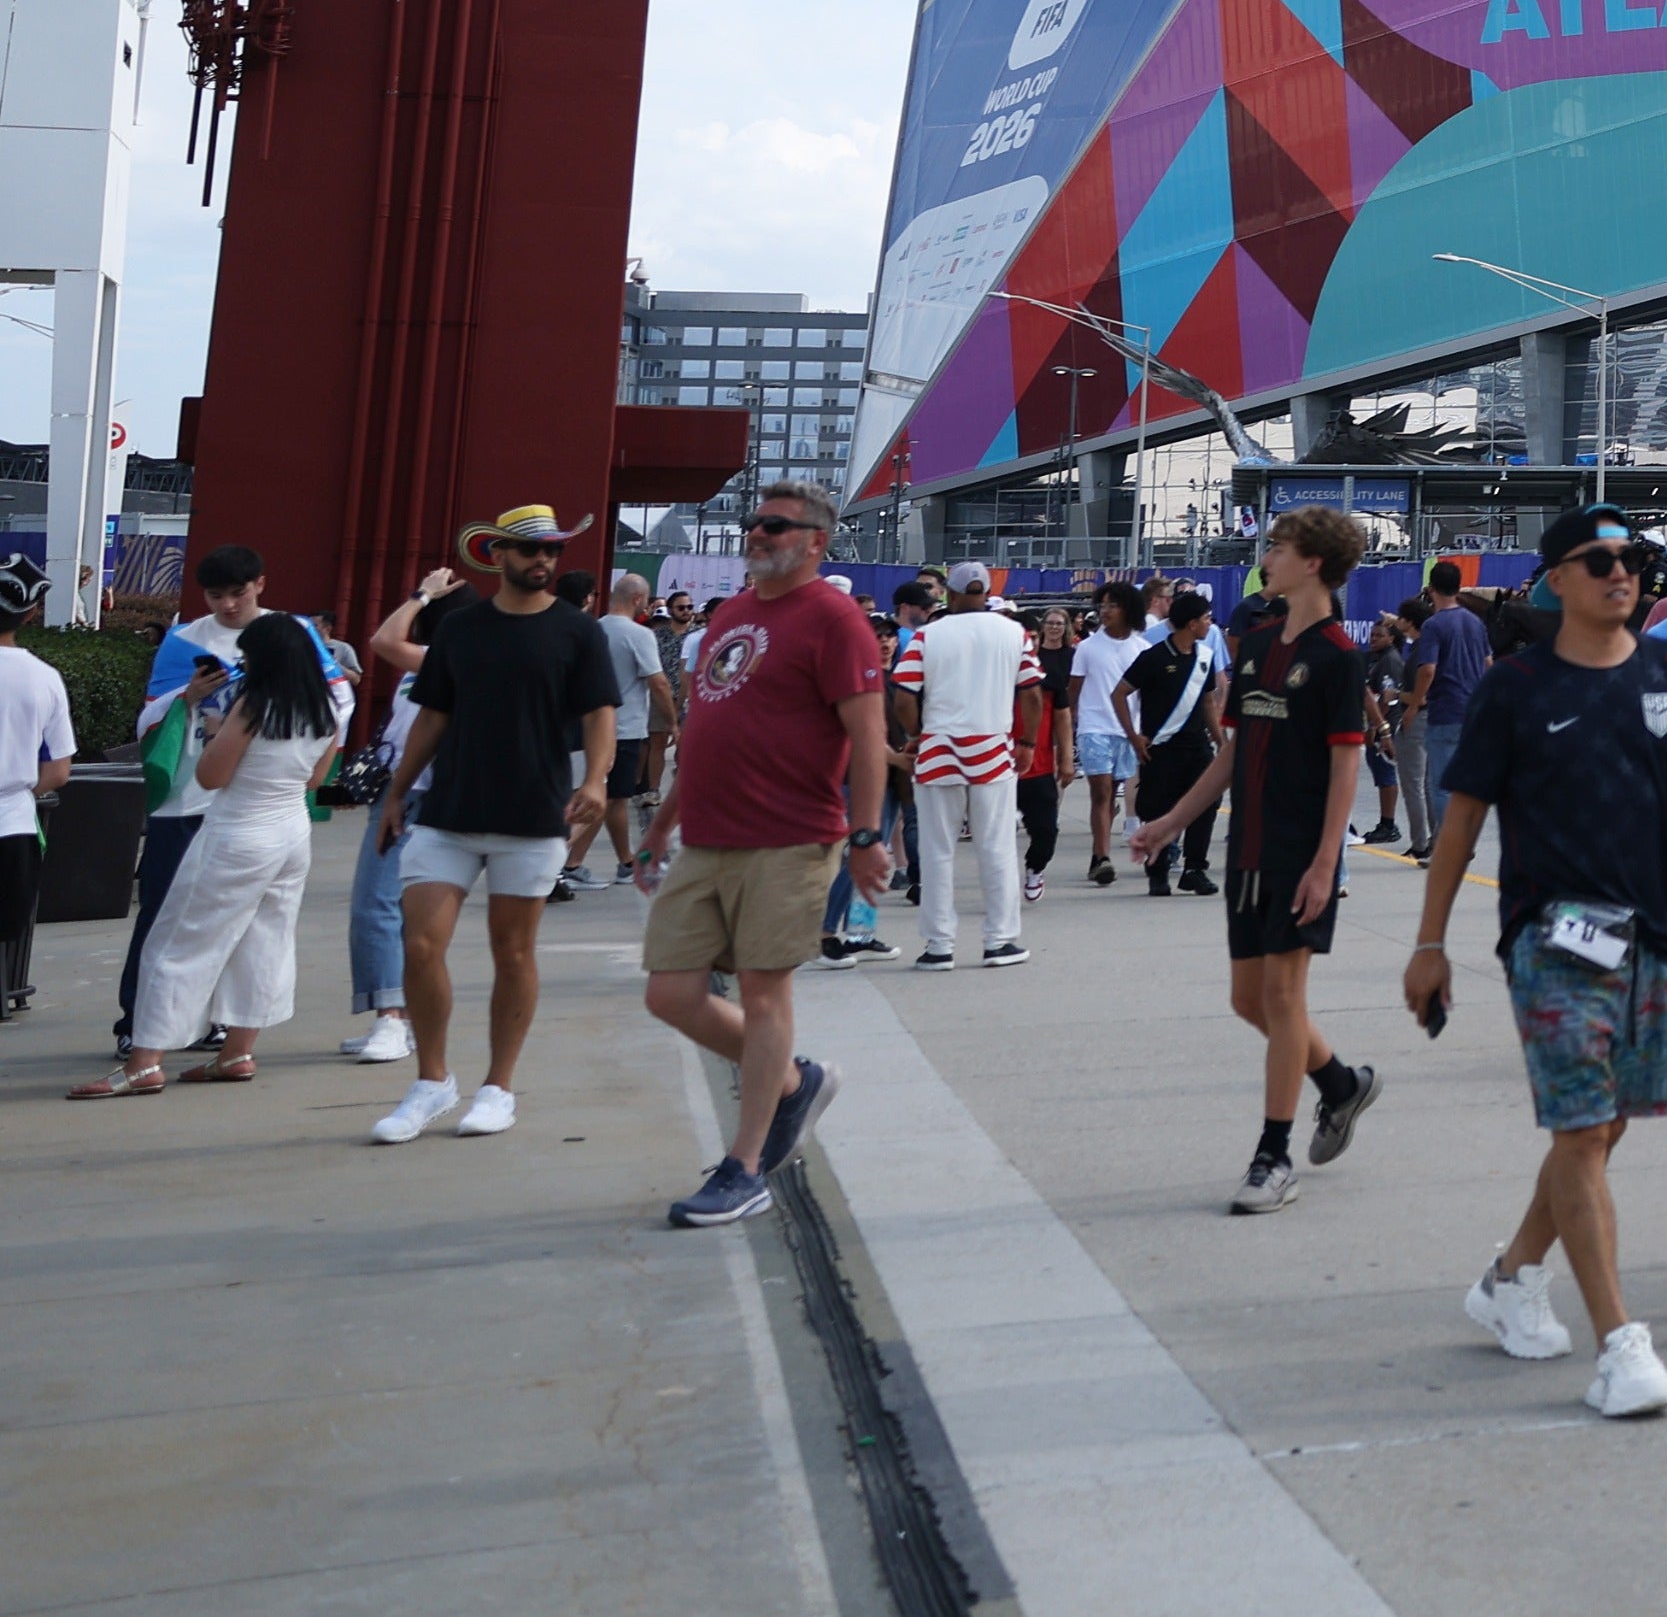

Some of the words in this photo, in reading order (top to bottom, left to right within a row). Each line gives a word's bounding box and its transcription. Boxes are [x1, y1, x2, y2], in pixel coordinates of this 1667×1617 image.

[984, 74, 1031, 115] WORLD
[1025, 66, 1058, 104] CUP
[960, 101, 1042, 168] 2026
[1295, 490, 1374, 500] ACCESSILITY
[1375, 490, 1405, 501] LANE
